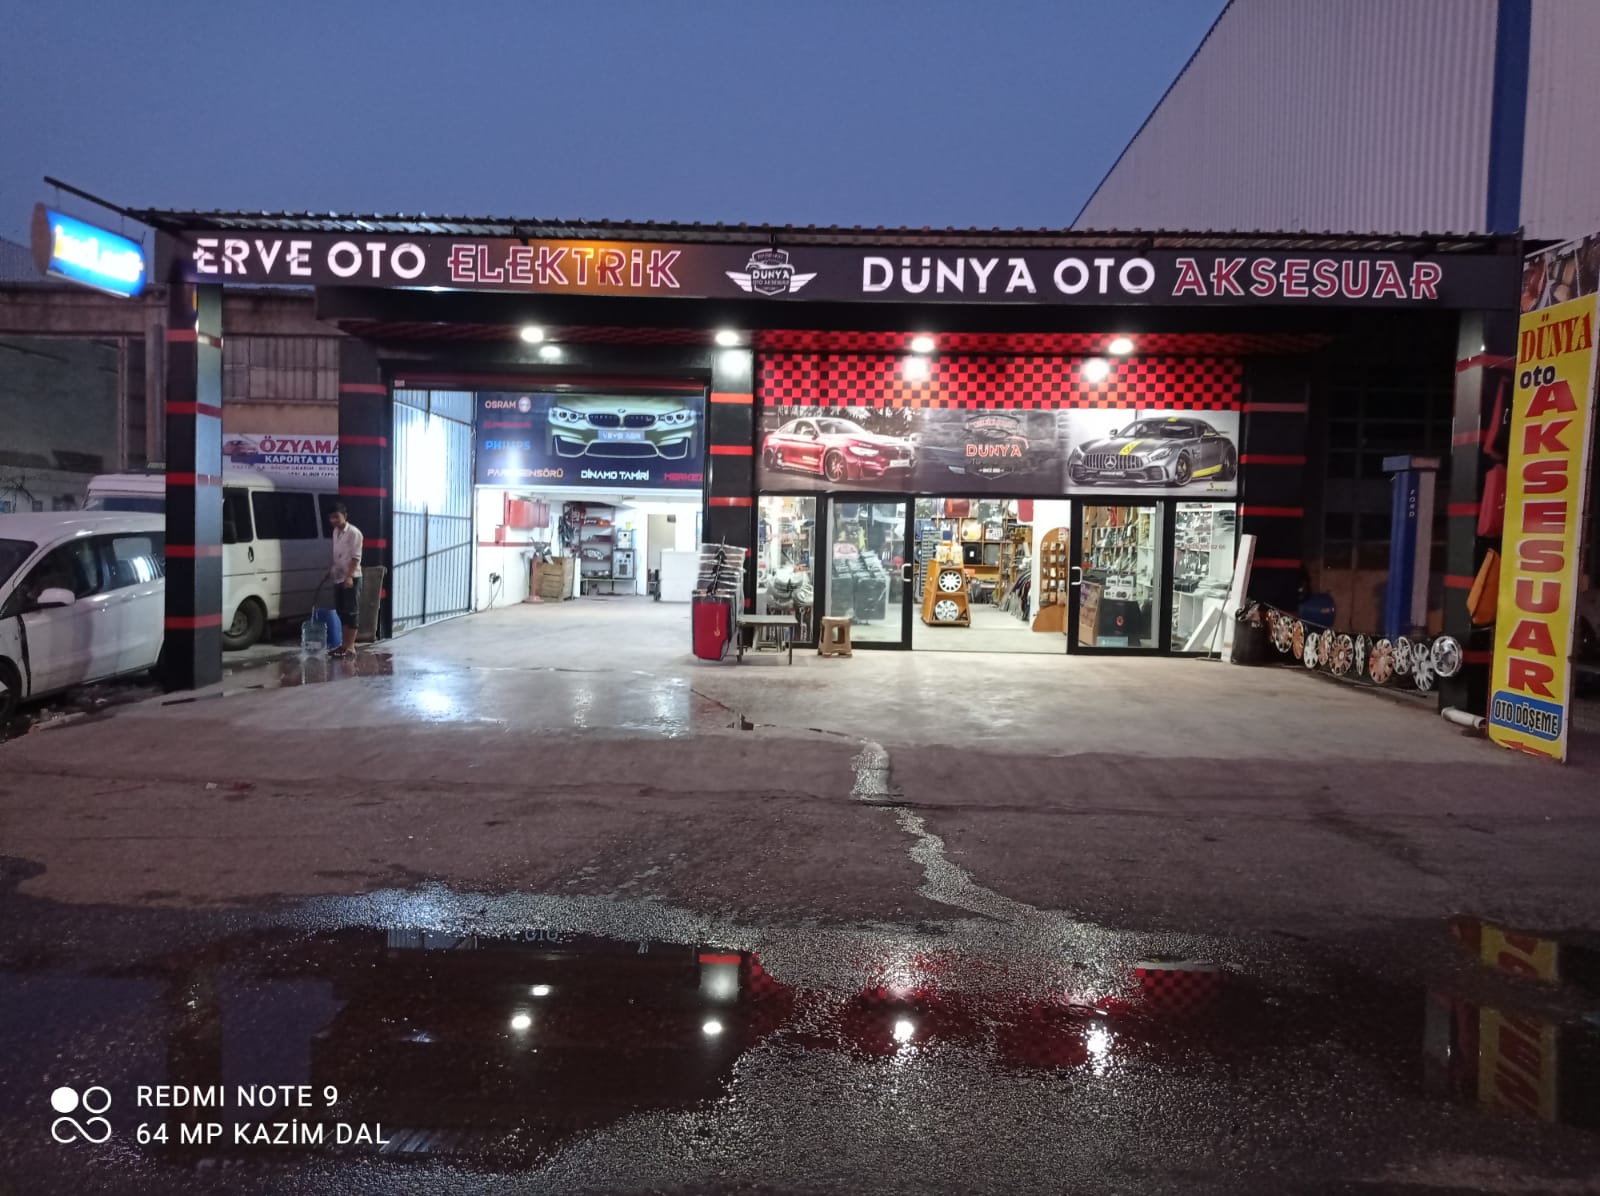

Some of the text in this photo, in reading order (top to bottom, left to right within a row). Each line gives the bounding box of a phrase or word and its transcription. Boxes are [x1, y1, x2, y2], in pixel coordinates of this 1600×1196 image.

[327, 242, 427, 279] OTO
[447, 243, 683, 290] ELEKTRİK
[752, 270, 790, 280] DUNYA
[862, 256, 1443, 300] DÜNYA OTO AKSESUAR
[1520, 311, 1593, 367] DÜNYA
[1519, 364, 1556, 390] oto
[485, 400, 516, 409] OSRAM
[265, 455, 314, 464] KAPORTA
[316, 455, 323, 463] &
[966, 444, 1022, 457] DUNYA
[580, 468, 650, 481] DİNAMO TAMİRİ
[1507, 378, 1578, 699] AKSESUAR
[1494, 699, 1559, 736] OTO DÖŞEME
